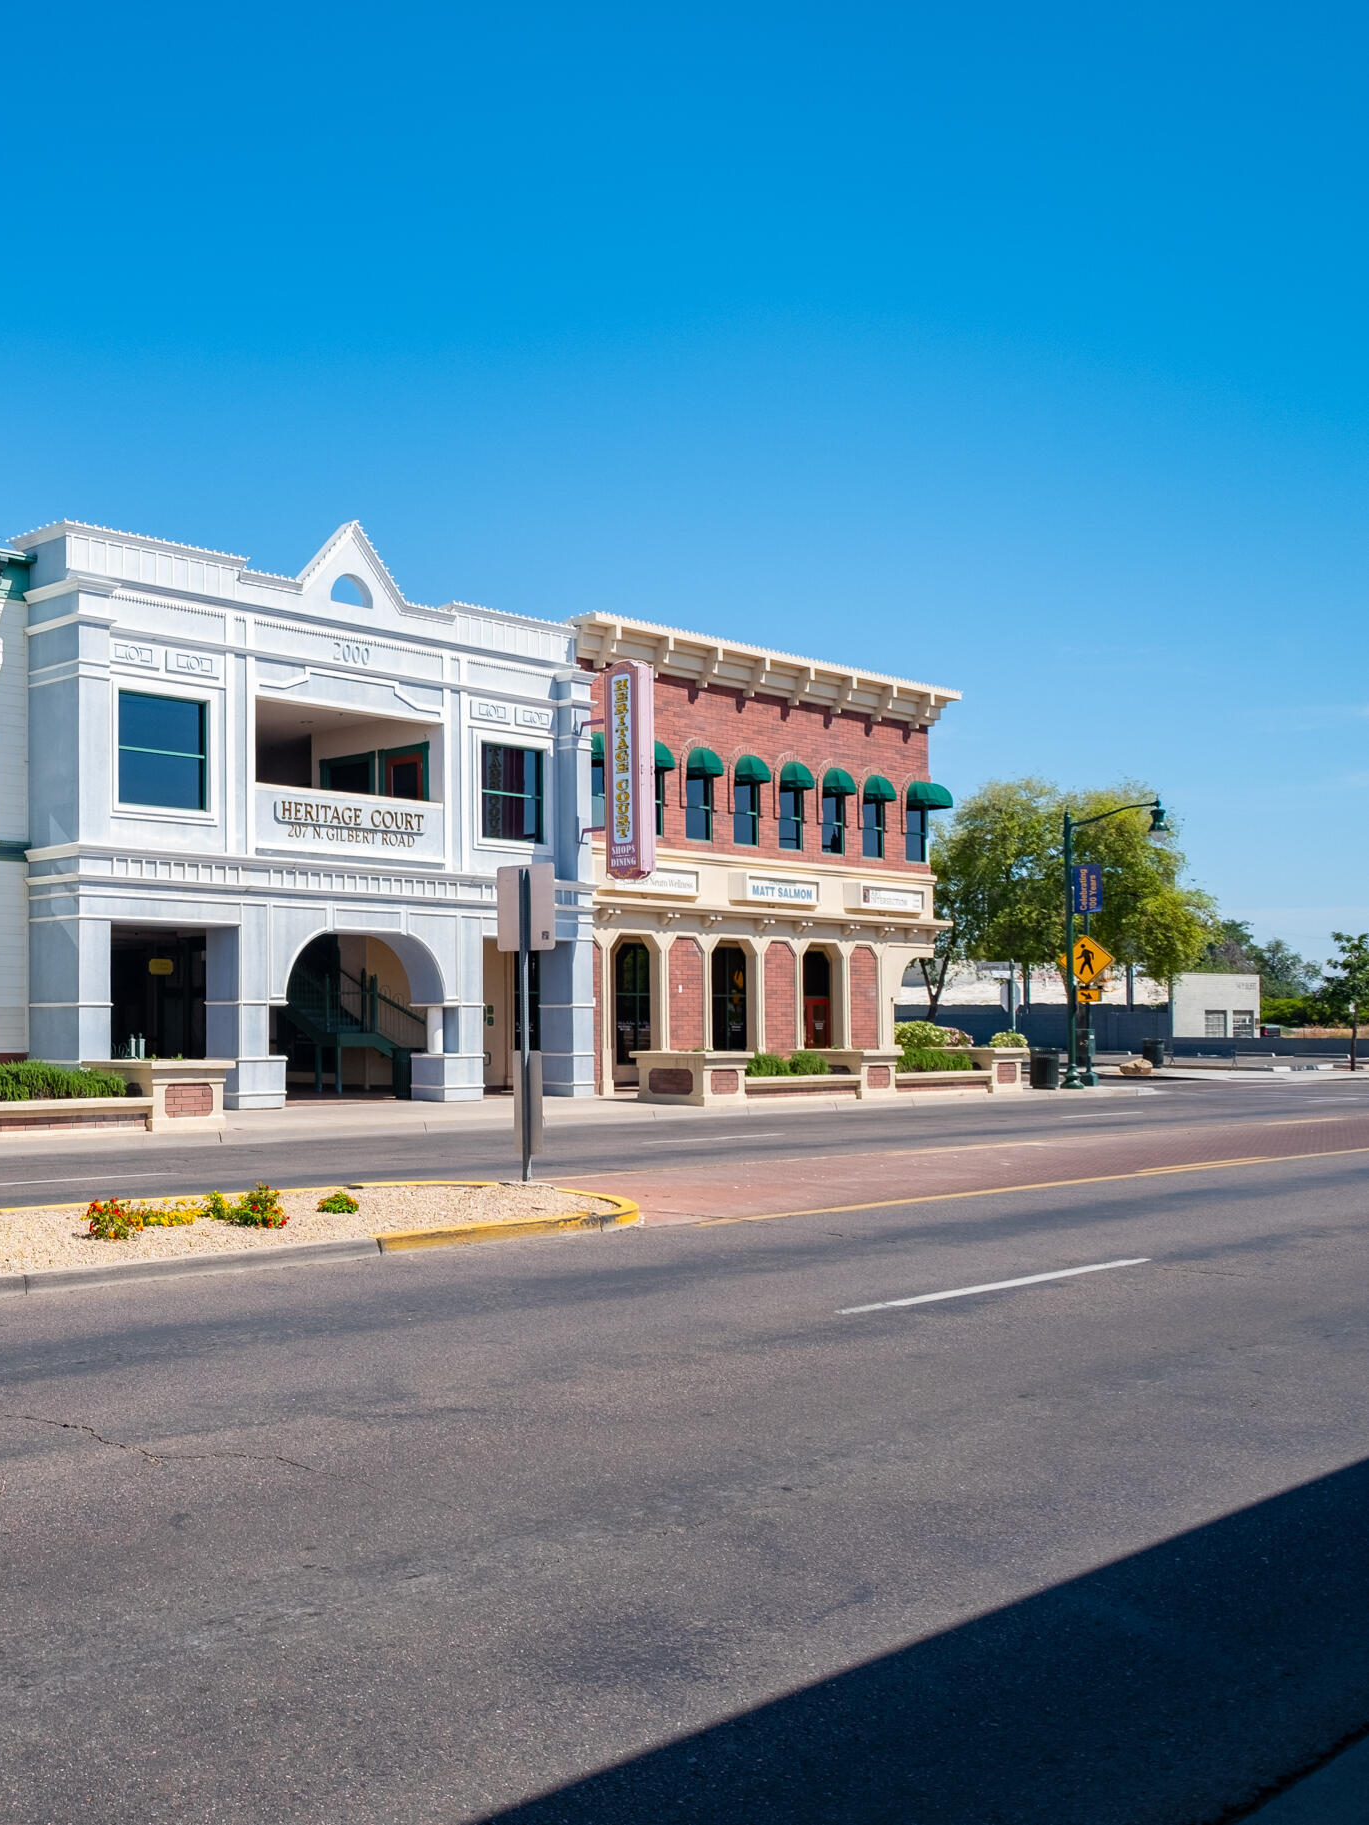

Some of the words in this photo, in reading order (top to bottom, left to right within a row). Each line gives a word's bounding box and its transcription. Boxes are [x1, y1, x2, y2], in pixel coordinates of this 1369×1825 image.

[333, 642, 369, 665] 2000
[614, 679, 629, 774] HERITAGE
[281, 800, 362, 826] HERITAGE
[371, 809, 424, 832] COURT
[616, 779, 630, 838] COURT
[287, 824, 309, 838] 207
[312, 826, 324, 840] N.
[326, 827, 378, 846] GILBERT
[382, 832, 415, 848] ROAD
[611, 845, 636, 855] SHOPS
[611, 857, 637, 867] DINING
[650, 877, 668, 888] Neuro
[668, 879, 694, 889] Wellness
[752, 885, 775, 897] MATT
[777, 887, 813, 900] SALMON
[1079, 869, 1088, 910] Celebrating
[1089, 874, 1097, 896] Years
[1089, 896, 1097, 909] 100
